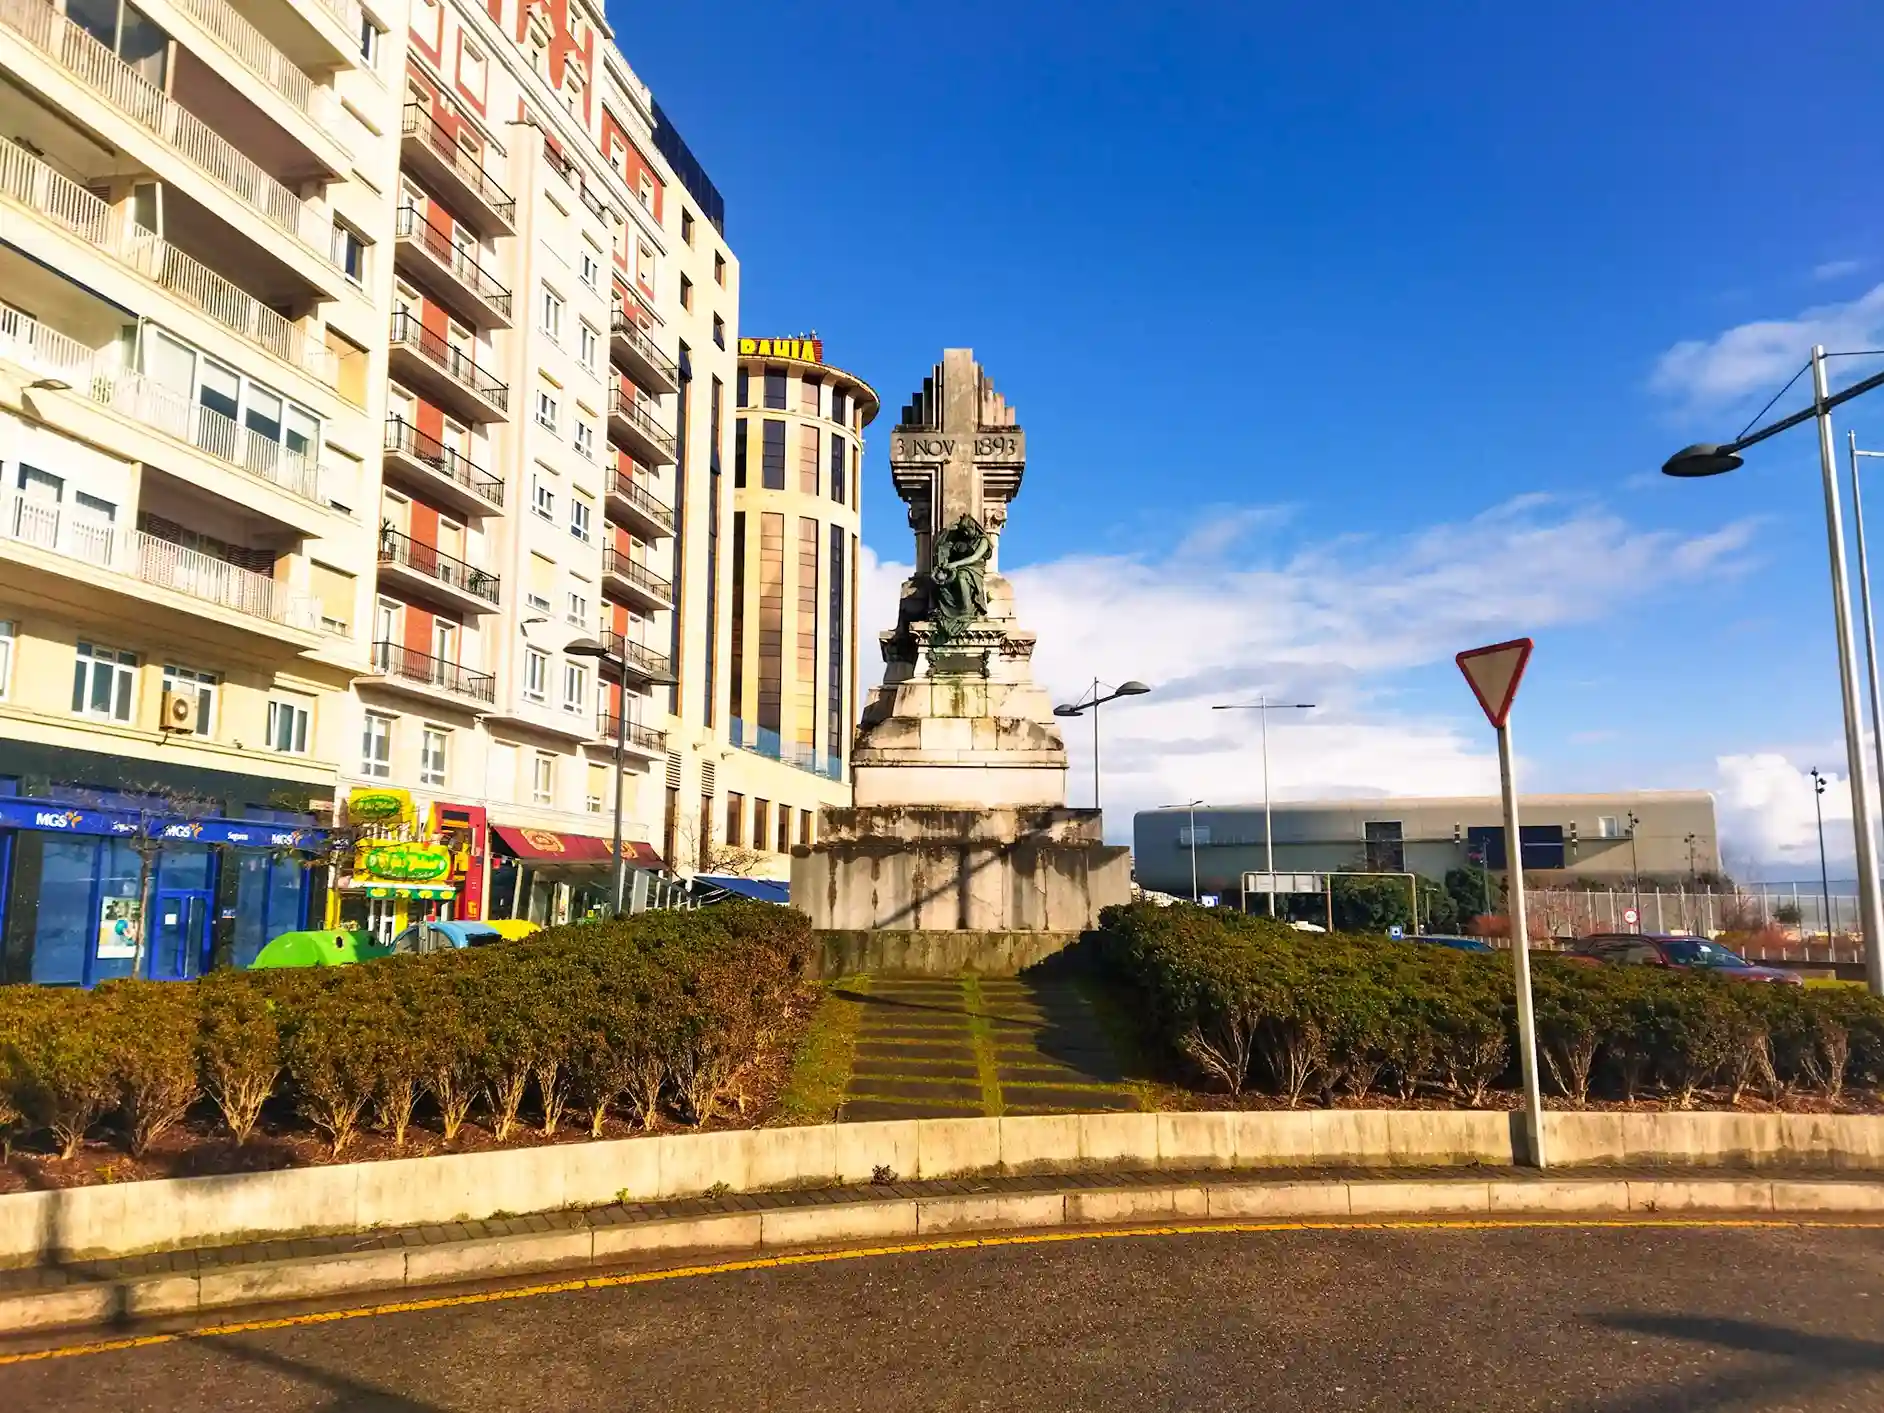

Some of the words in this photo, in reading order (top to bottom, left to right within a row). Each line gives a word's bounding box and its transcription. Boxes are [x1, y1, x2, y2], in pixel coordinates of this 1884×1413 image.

[896, 438, 905, 456] 3
[912, 439, 956, 457] NOV
[973, 437, 1018, 457] 1893
[36, 812, 67, 828] MGS
[164, 824, 191, 838] MGS
[271, 834, 294, 846] MGS
